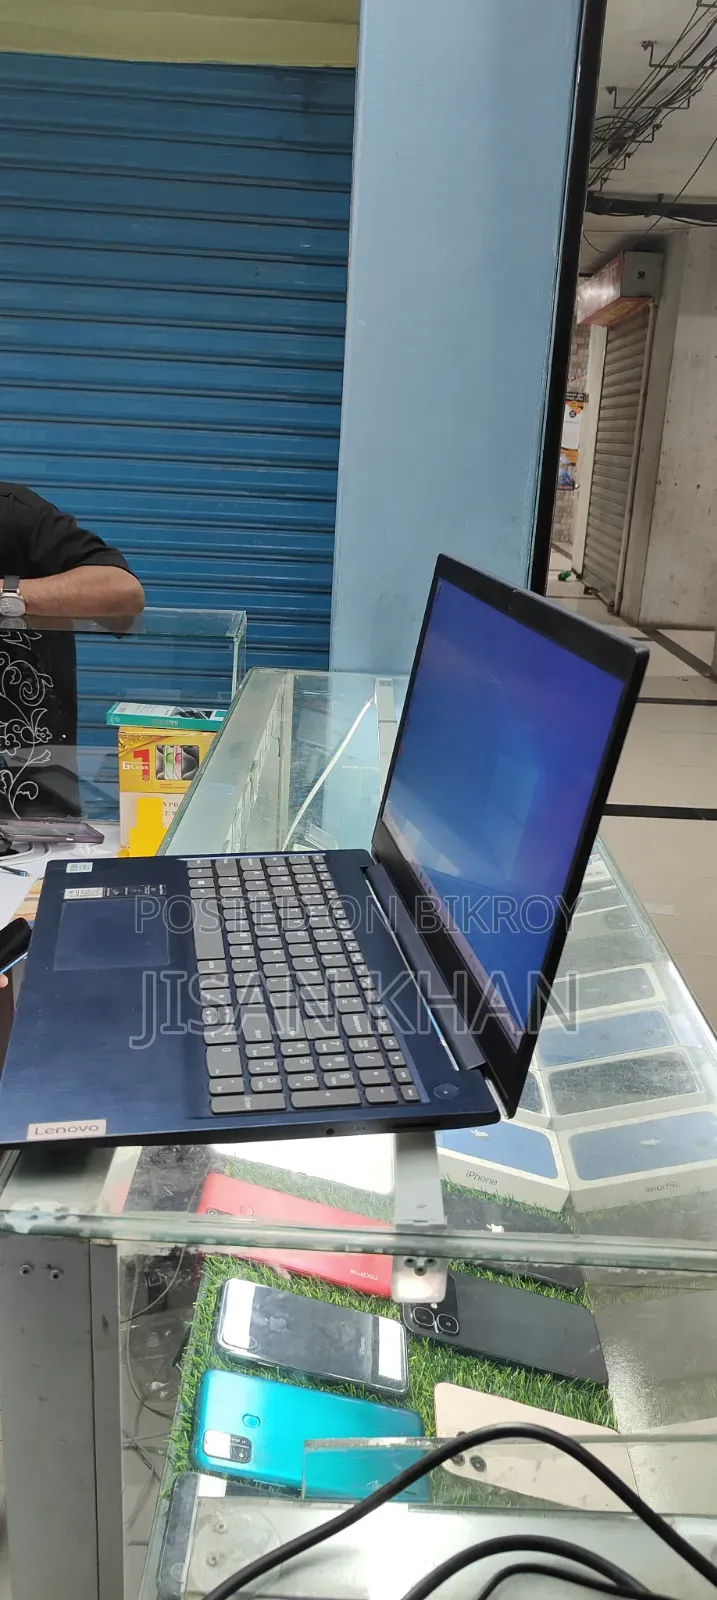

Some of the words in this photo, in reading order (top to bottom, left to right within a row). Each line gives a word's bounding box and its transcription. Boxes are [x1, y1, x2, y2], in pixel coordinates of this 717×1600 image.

[244, 1097, 252, 1109] Enter
[34, 1124, 100, 1135] Lenovo
[465, 1170, 498, 1185] iPhone
[350, 1270, 378, 1282] realme
